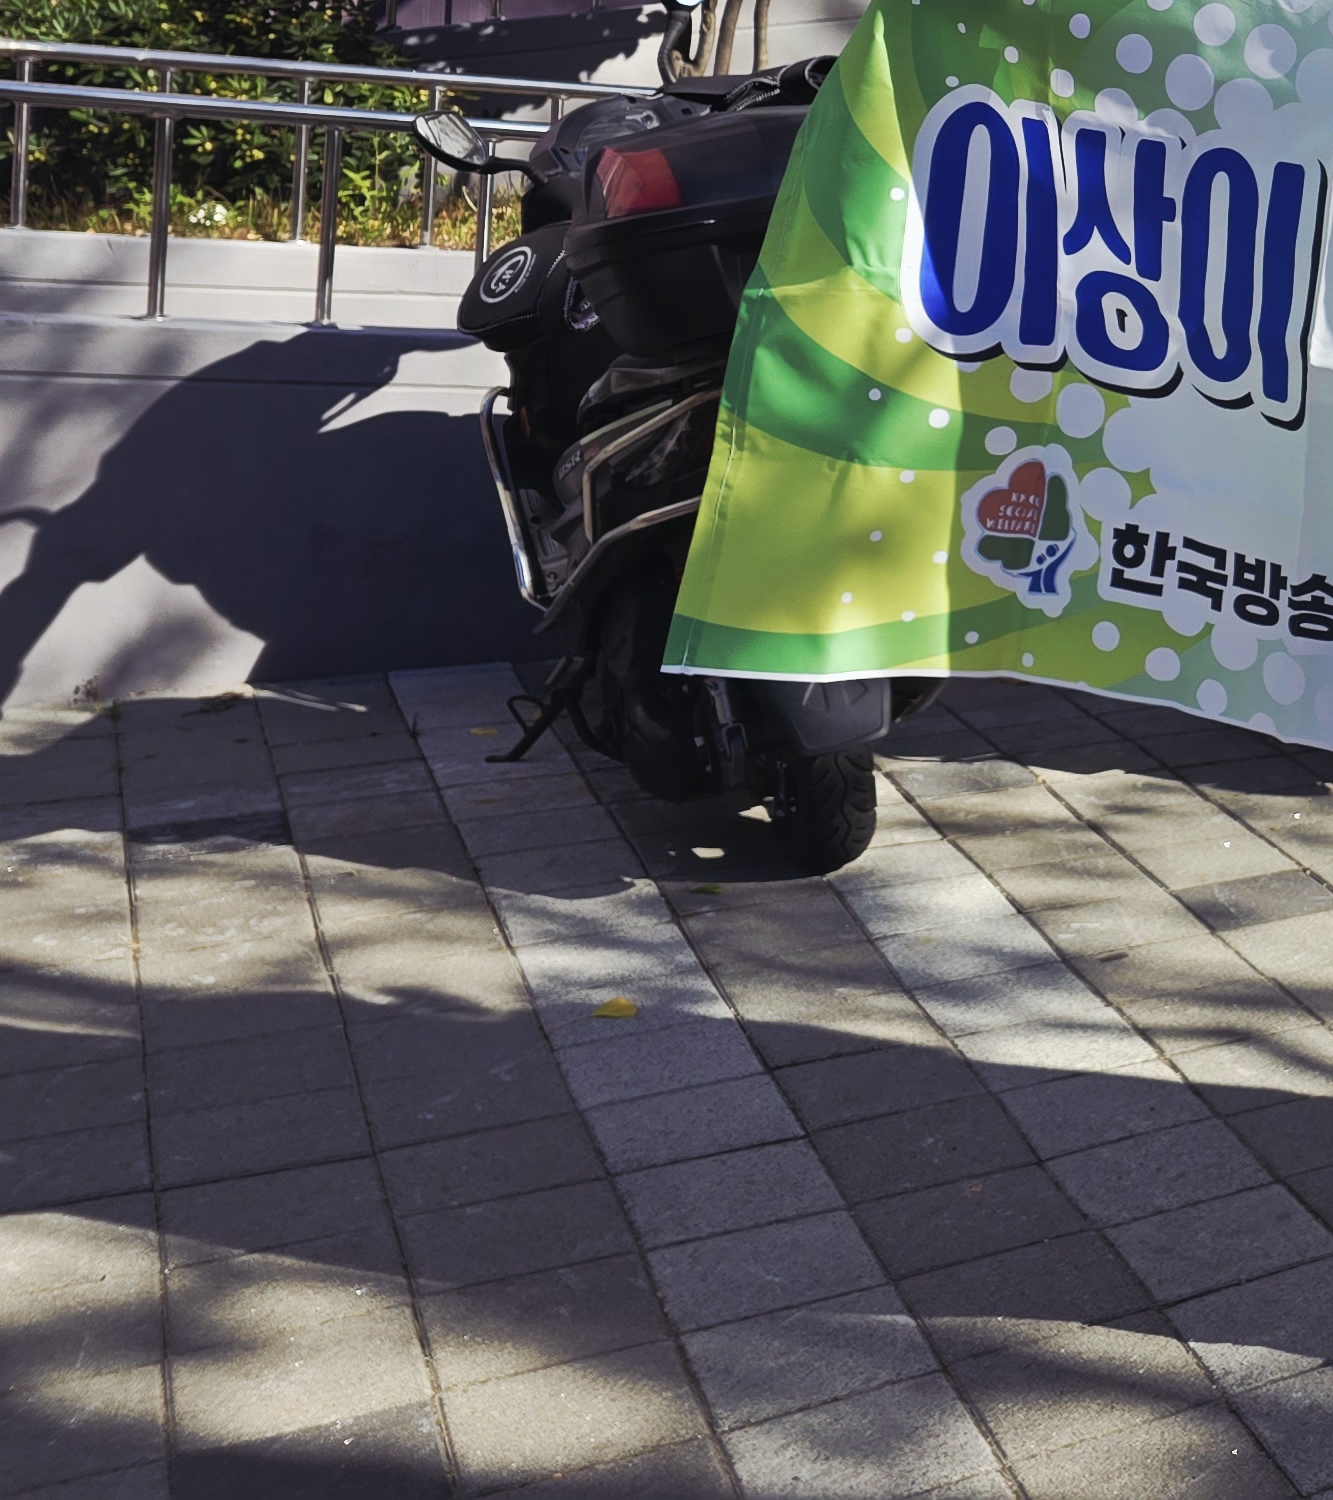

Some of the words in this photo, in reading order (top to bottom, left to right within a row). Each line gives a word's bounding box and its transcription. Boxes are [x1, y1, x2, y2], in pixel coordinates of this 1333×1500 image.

[914, 100, 1307, 404] 이상이
[998, 505, 1039, 521] SOCIAL
[986, 517, 1036, 534] WELFARE
